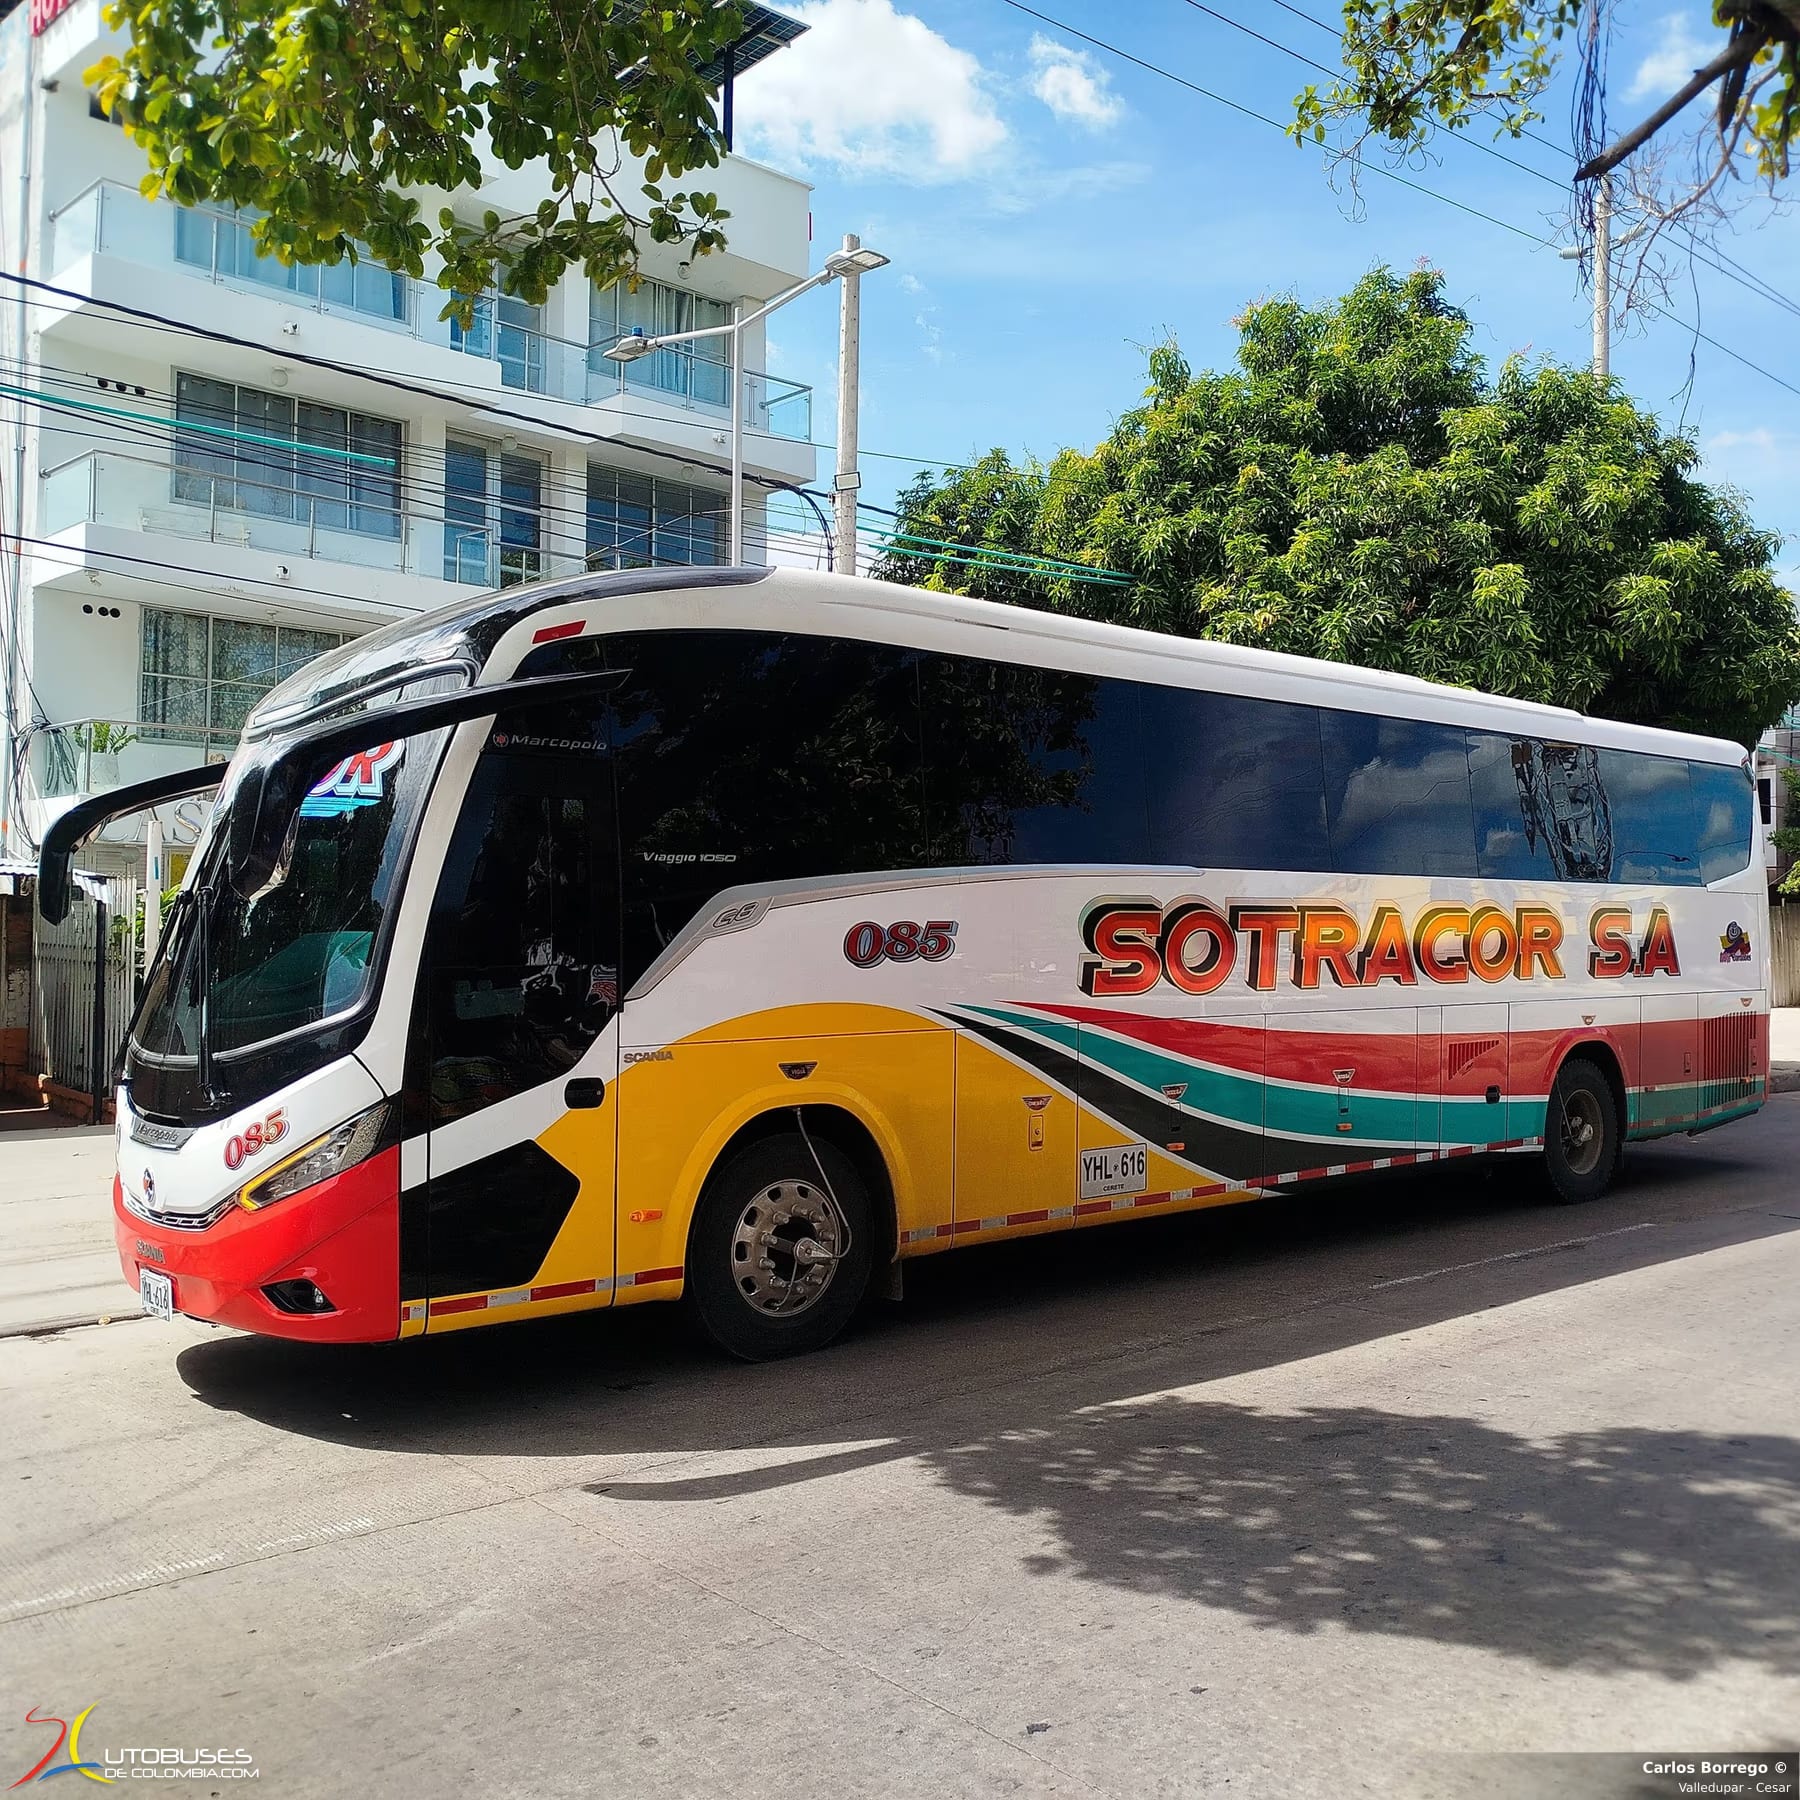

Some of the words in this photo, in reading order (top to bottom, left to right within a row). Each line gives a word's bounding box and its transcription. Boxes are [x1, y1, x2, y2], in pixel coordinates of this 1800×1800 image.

[511, 734, 607, 750] Marcopolo
[643, 851, 696, 864] Viaggio
[699, 853, 737, 863] 1050
[712, 901, 759, 928] G8
[843, 920, 960, 969] 085
[1076, 895, 1566, 998] SOTRACOR
[1586, 900, 1682, 979] S.A
[623, 1050, 675, 1064] SCANIA
[223, 1106, 291, 1171] 085
